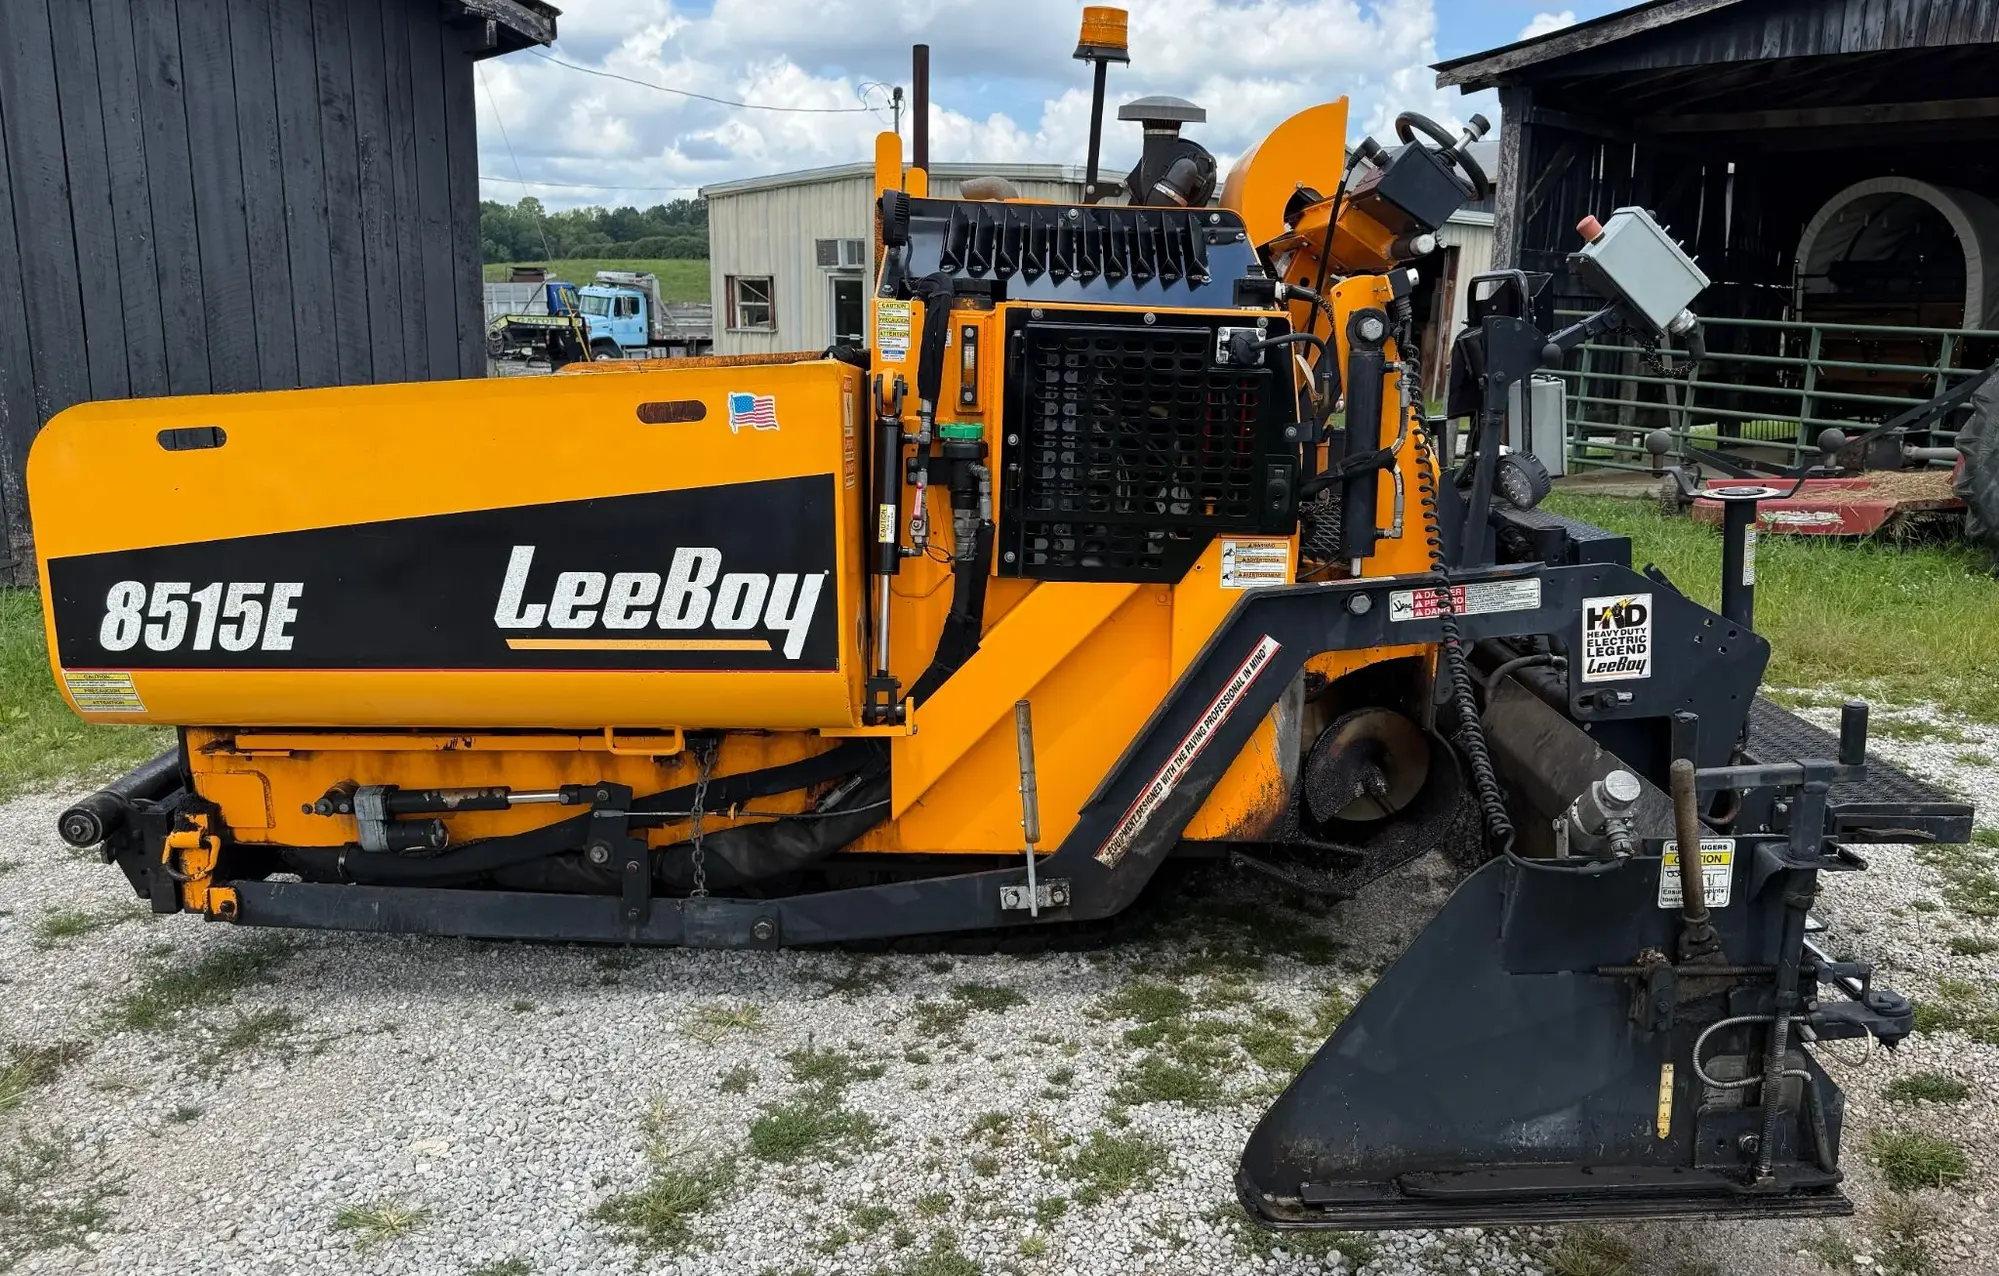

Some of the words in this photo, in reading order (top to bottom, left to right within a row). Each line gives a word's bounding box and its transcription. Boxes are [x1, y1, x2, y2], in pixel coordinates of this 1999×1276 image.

[516, 317, 559, 325] GATOR
[879, 508, 887, 538] CAUTION
[1424, 588, 1462, 598] DAER
[494, 545, 830, 660] LeeBoy
[99, 580, 304, 653] 8515E
[1424, 605, 1462, 616] DANGR
[1587, 630, 1620, 639] HEAVY
[1620, 628, 1647, 636] DUTY
[1587, 635, 1647, 648] ELECTRIC
[1587, 644, 1647, 658] LEGEND
[1587, 656, 1647, 675] LeeBoy
[1134, 784, 1163, 821] DESIGNED
[1160, 765, 1177, 785] WITH
[1174, 750, 1188, 768] THE
[1184, 726, 1207, 755] PAVING
[1204, 677, 1245, 729] PROFESSIONAL
[1242, 667, 1252, 680] IN
